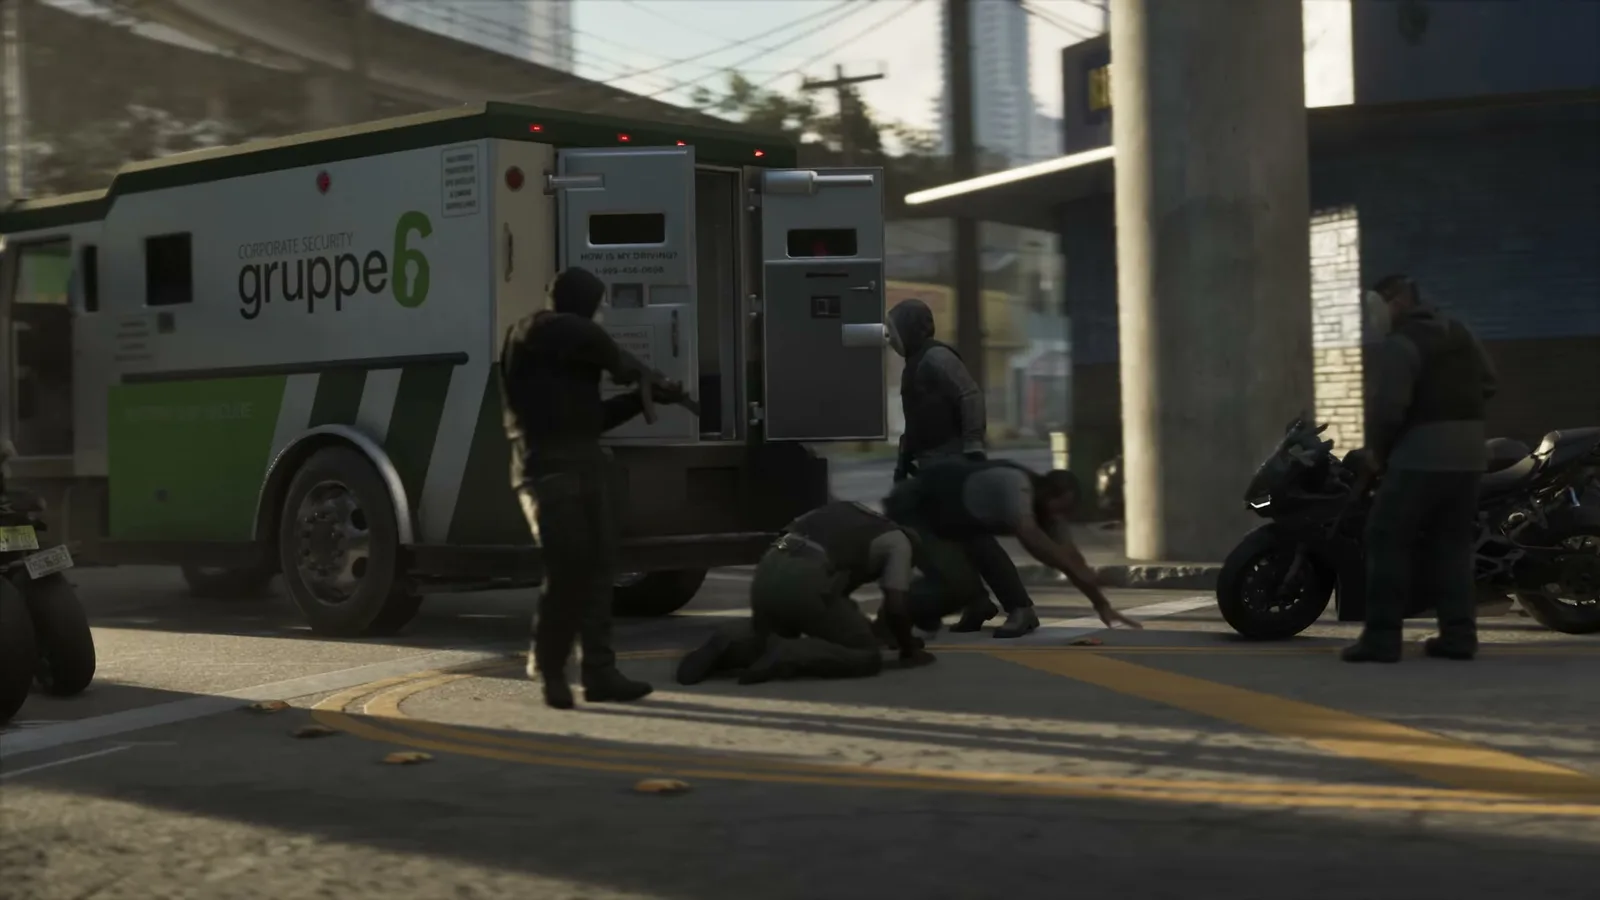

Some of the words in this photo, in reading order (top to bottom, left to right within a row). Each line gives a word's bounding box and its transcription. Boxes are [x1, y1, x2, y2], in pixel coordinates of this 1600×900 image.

[237, 236, 299, 260] CORPORATE
[302, 230, 354, 254] SECURITY
[580, 252, 604, 261] HOW
[605, 252, 615, 261] IS
[617, 252, 631, 260] MY
